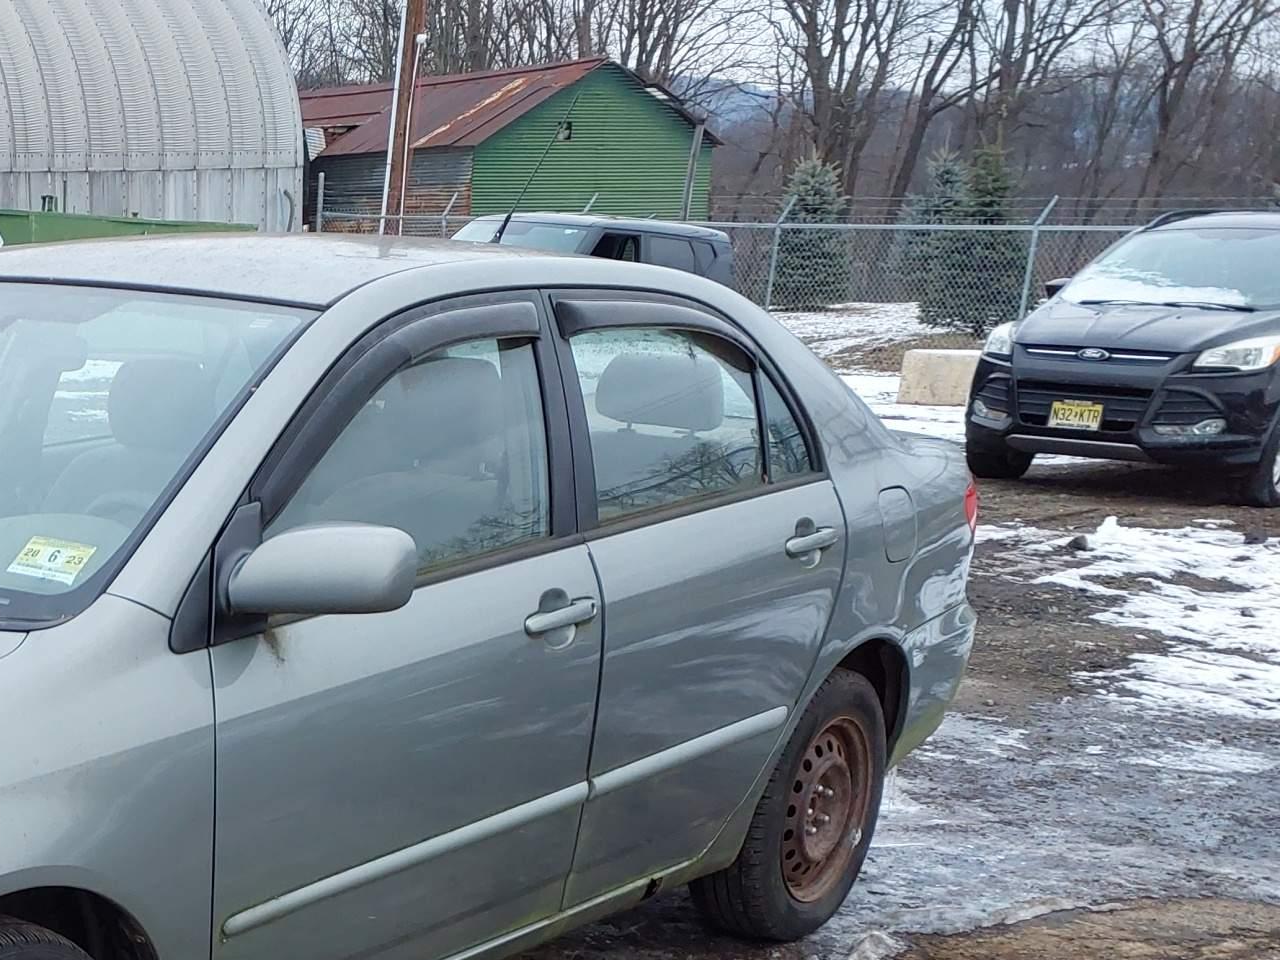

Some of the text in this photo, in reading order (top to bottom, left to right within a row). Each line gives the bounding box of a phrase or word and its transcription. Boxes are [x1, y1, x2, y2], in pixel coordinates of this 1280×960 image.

[24, 547, 84, 565] 20 6 23
